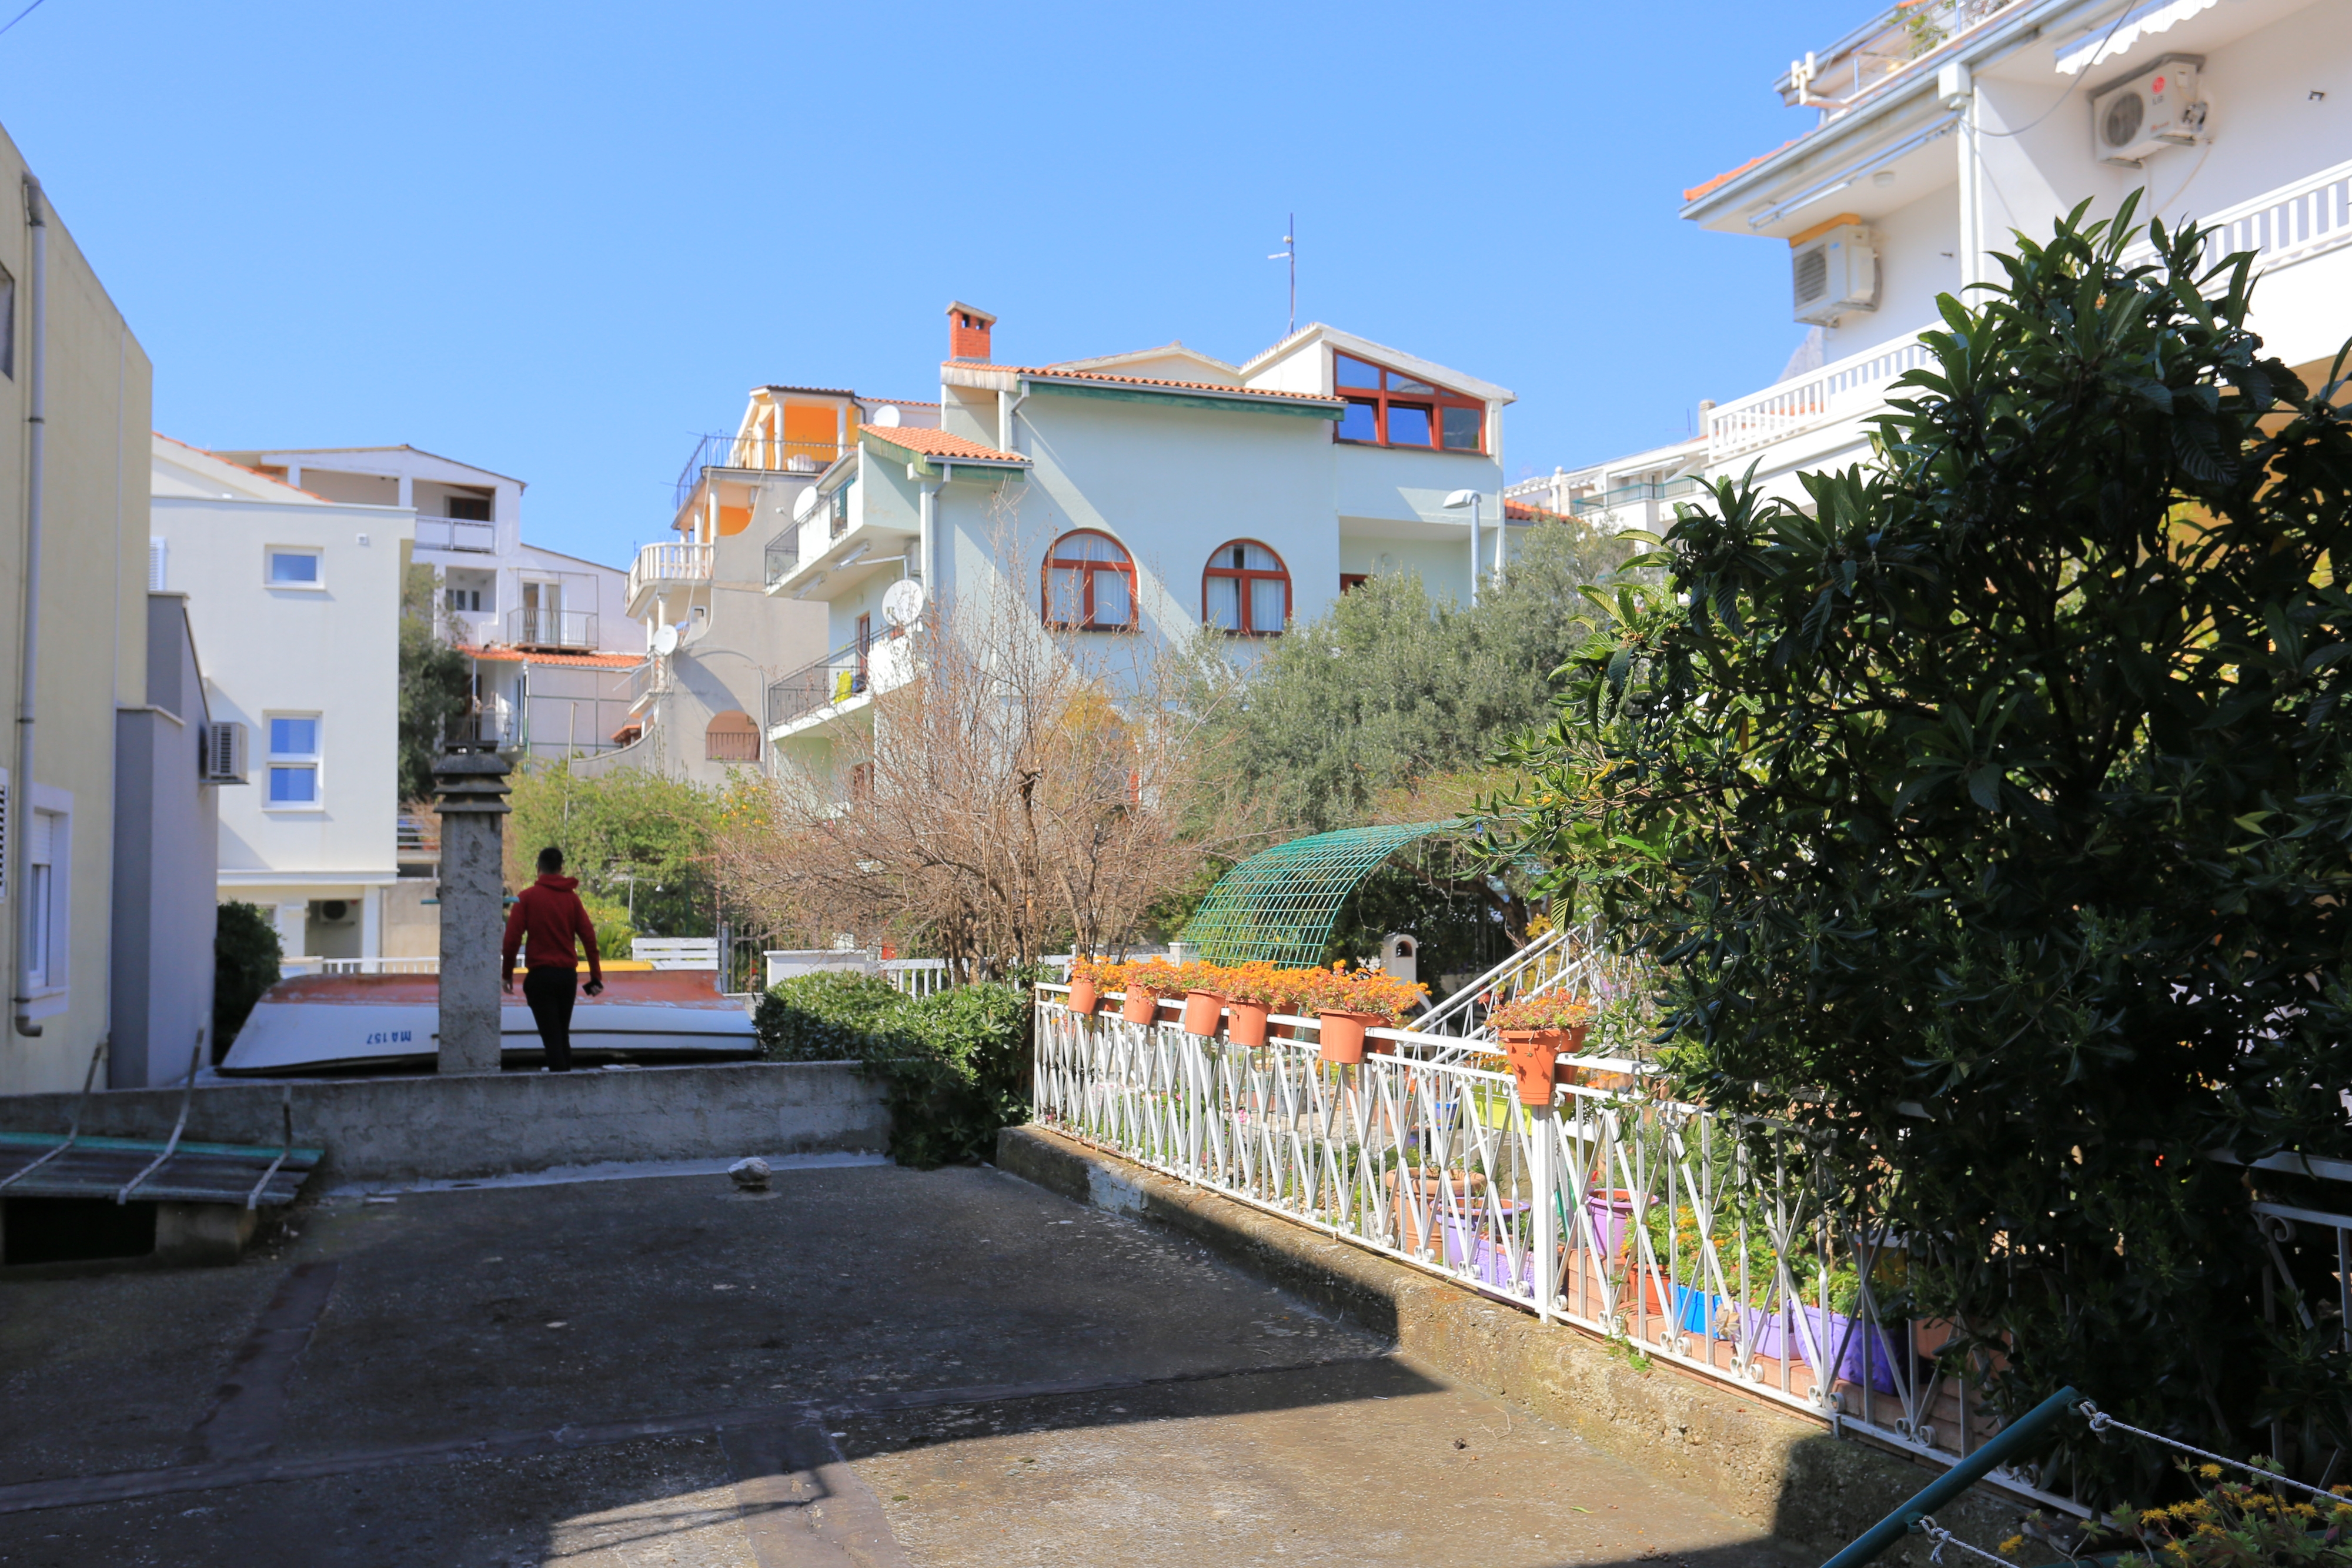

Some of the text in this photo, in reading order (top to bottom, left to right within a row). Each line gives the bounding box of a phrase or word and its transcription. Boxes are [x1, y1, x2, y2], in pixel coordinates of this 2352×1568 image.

[2153, 95, 2163, 105] LG
[367, 1031, 411, 1044] MA 157
